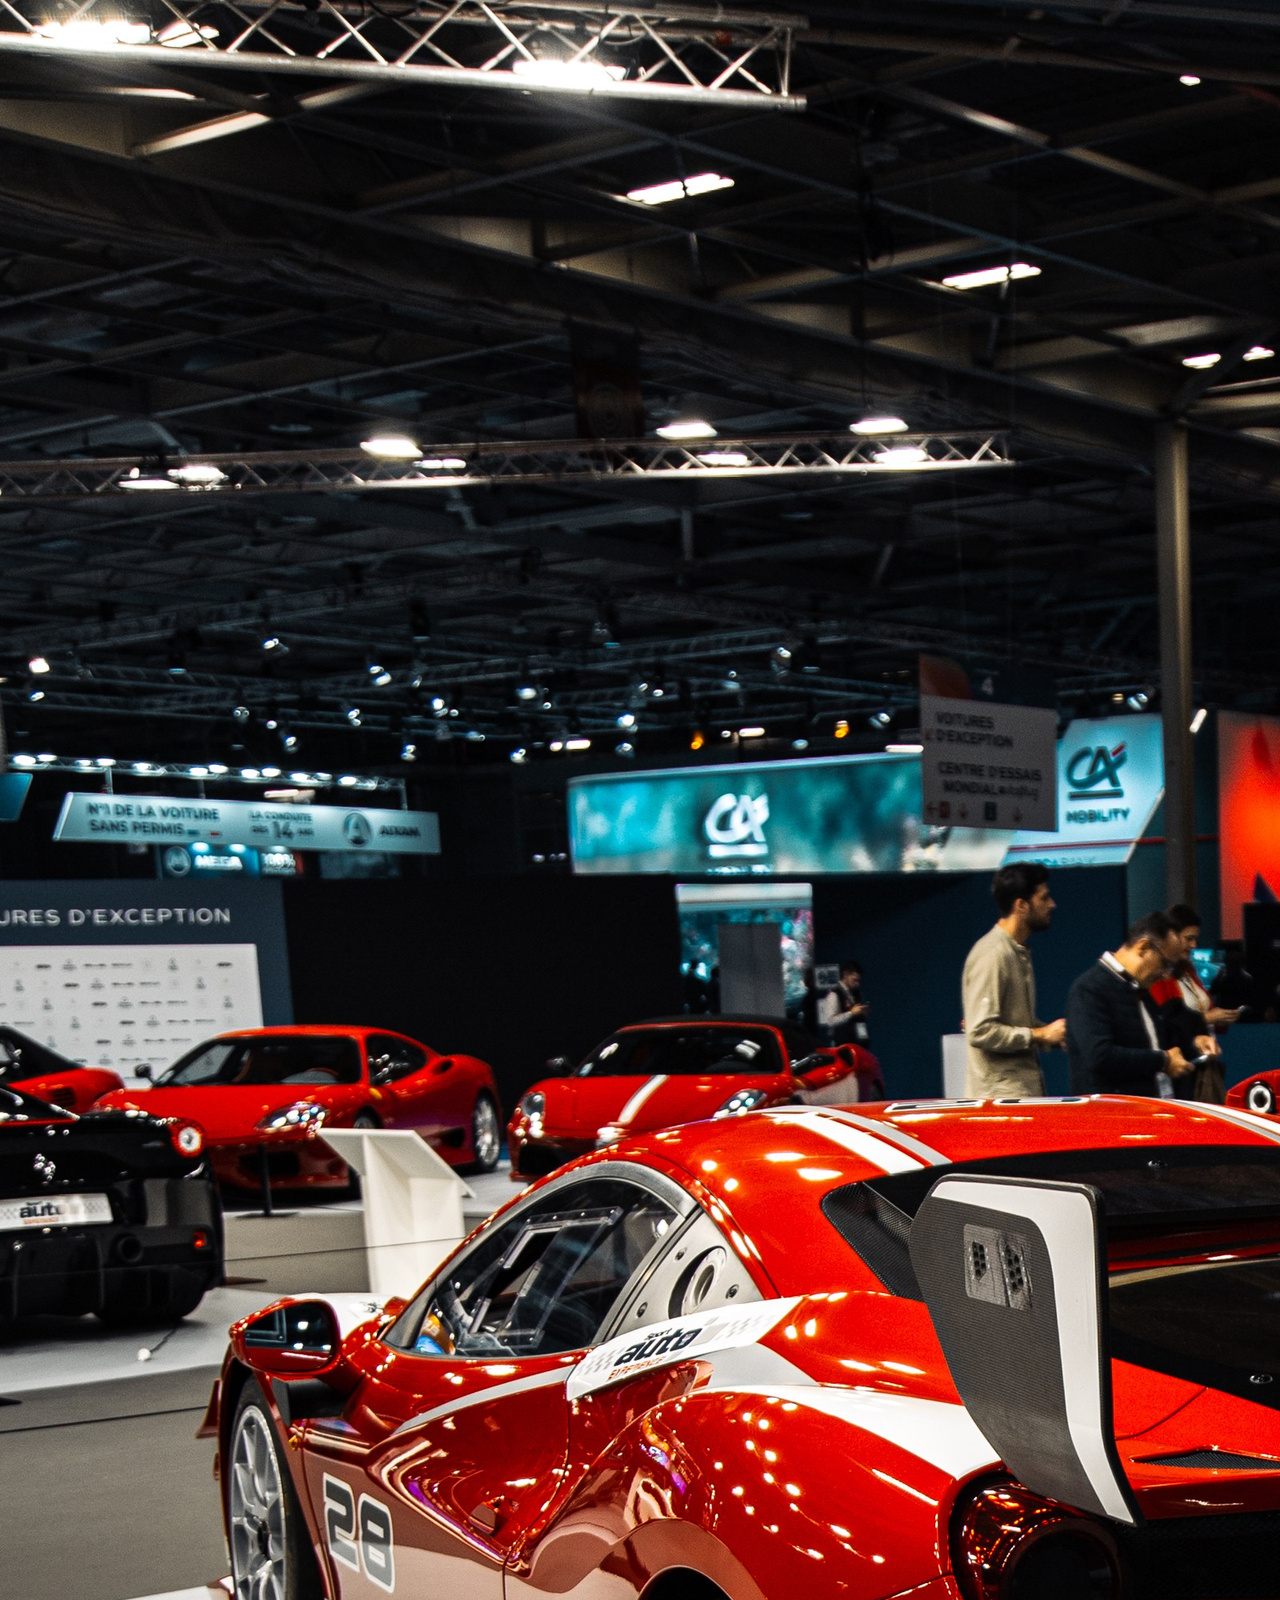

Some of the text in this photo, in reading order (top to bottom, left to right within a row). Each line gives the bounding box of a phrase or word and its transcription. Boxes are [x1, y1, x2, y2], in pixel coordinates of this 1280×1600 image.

[935, 711, 994, 729] VOITURES
[936, 729, 1013, 748] D'EXCEPTION
[939, 761, 984, 779] CENTRE
[114, 803, 133, 816] DE
[137, 804, 157, 818] LA
[159, 806, 220, 820] VOITURE
[1066, 807, 1131, 824] MOBILITY
[90, 819, 185, 835] SANS PERMIS
[271, 821, 294, 839] 14
[195, 855, 243, 870] MEGA
[68, 907, 232, 927] D'EXCEPTION
[613, 1327, 703, 1367] auto
[323, 1472, 395, 1593] 28
